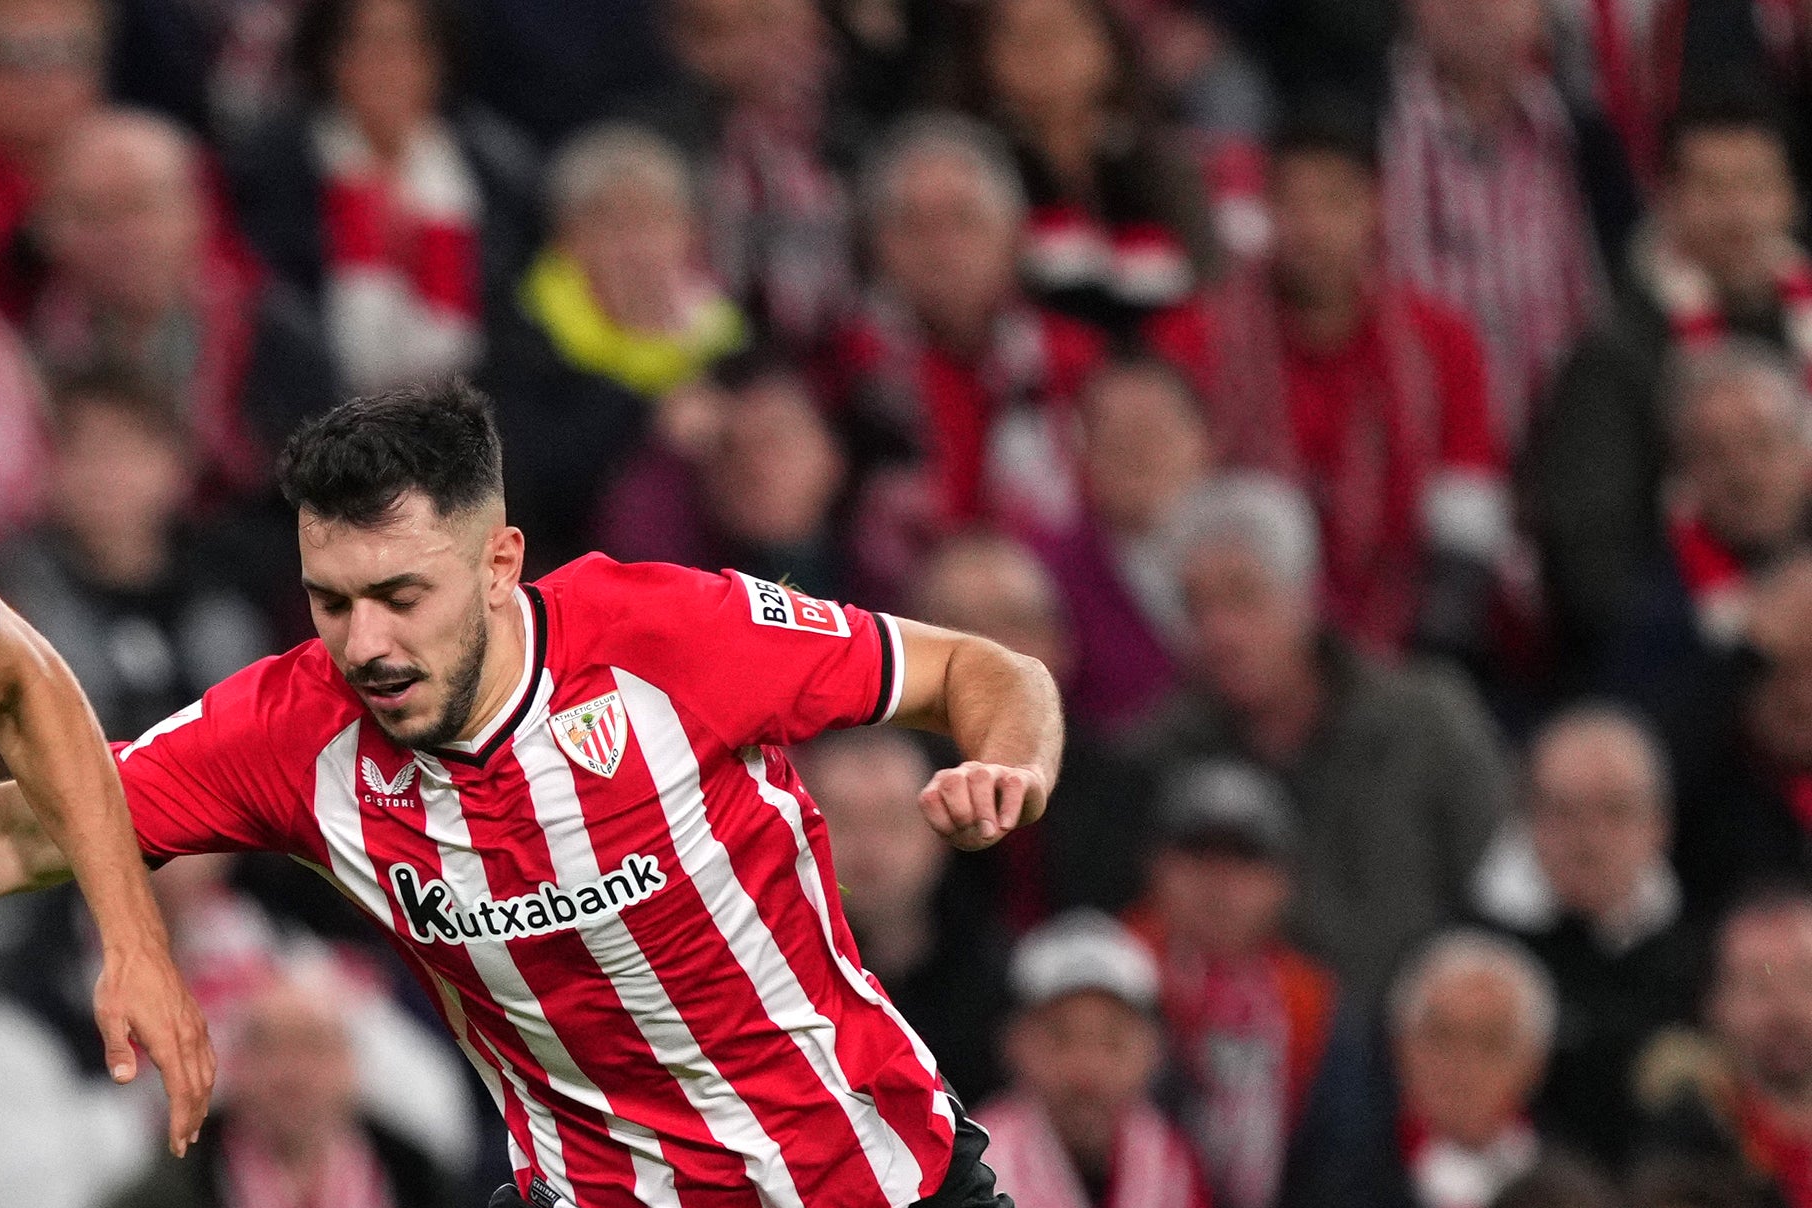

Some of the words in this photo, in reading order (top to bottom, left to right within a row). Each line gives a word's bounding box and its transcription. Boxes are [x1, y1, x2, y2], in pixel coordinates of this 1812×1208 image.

[554, 704, 592, 723] ATHLETIC
[593, 694, 616, 708] CLUB
[588, 748, 619, 775] BILBAO
[364, 794, 415, 808] CSTORE
[395, 858, 662, 939] Kutxabank
